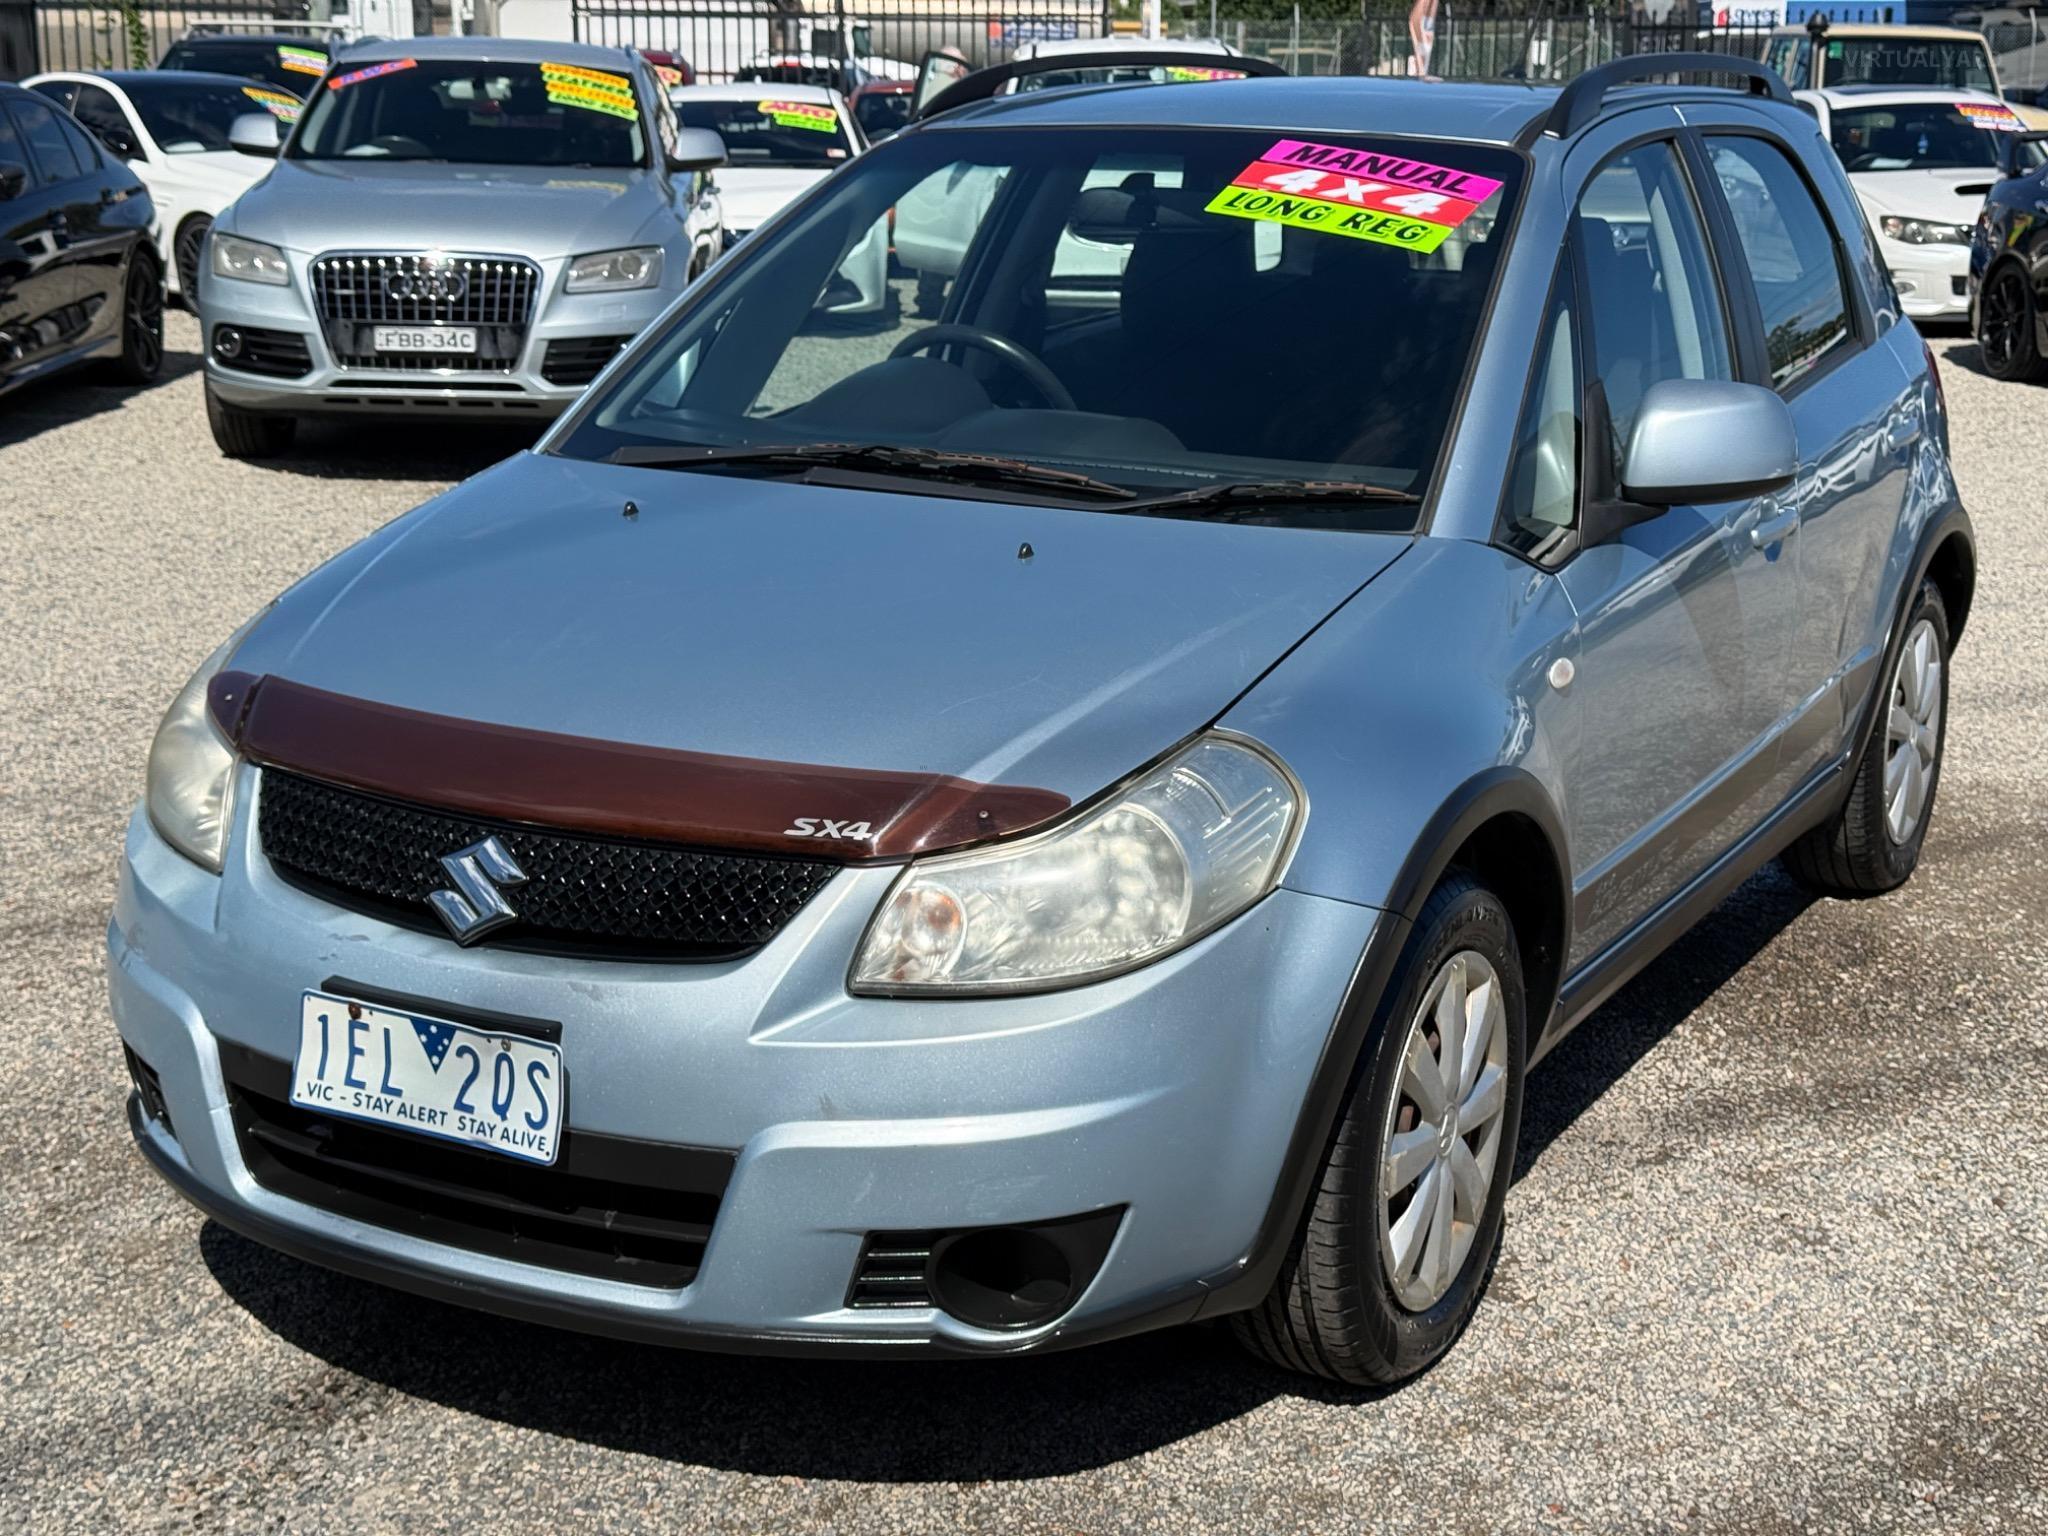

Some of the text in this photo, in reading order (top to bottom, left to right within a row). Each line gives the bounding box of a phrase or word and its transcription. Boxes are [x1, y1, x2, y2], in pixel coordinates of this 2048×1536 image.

[1283, 145, 1471, 194] MANUAL
[1223, 191, 1430, 241] LONG REG
[783, 817, 873, 841] SX4
[317, 1014, 550, 1131] 1EL 2QS
[307, 1081, 333, 1101] VIC
[353, 1092, 393, 1116] STAY
[397, 1102, 448, 1127] ALERT
[457, 1115, 496, 1139] STAY
[500, 1130, 547, 1152] ALIVE
